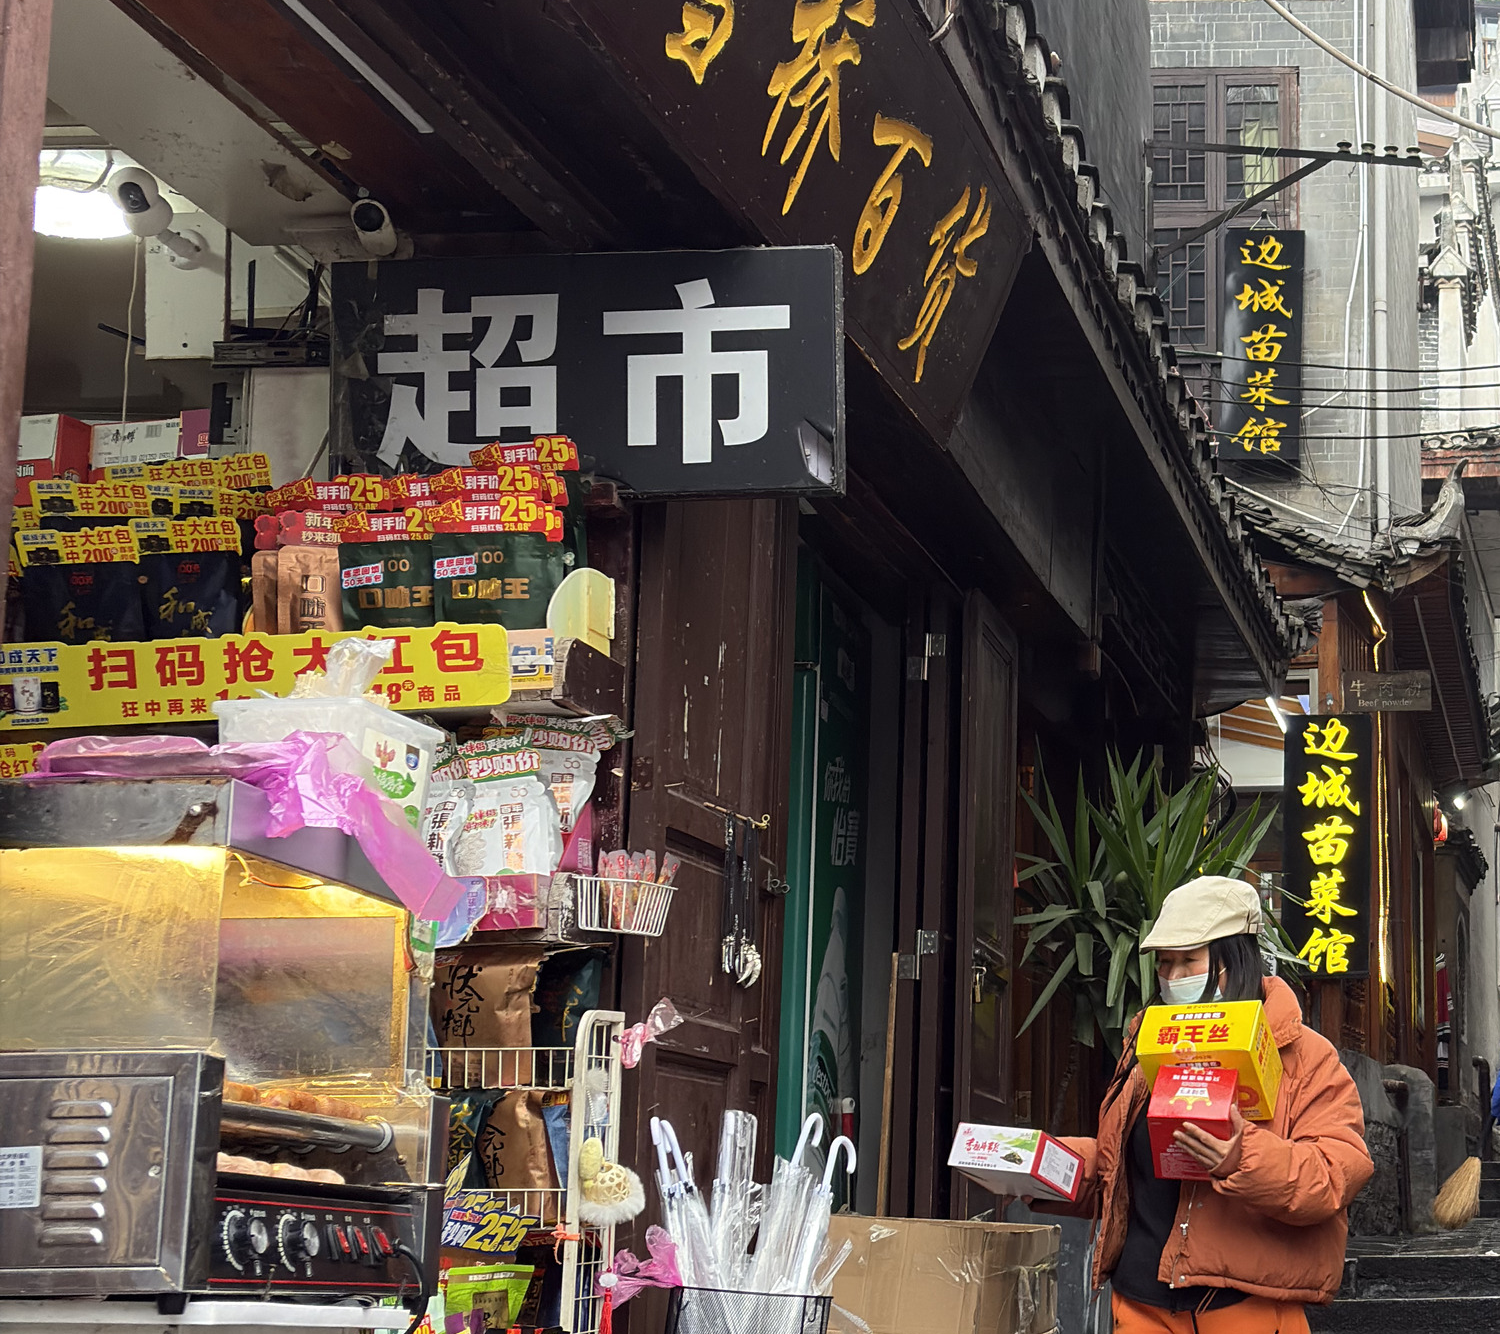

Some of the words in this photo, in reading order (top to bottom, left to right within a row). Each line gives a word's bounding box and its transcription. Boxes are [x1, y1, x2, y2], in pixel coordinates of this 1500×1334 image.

[1231, 235, 1292, 454] 边城苗菜馆
[377, 278, 790, 468] 超市
[316, 485, 349, 500] 到手价
[349, 477, 383, 503] 25
[466, 475, 499, 490] 到手价
[498, 466, 533, 492] 25
[465, 506, 500, 521] 到手价
[500, 496, 537, 522] 25
[371, 517, 406, 531] 到手价
[87, 630, 484, 691] 扫码抢大红包
[1350, 680, 1422, 697] 牛肉粉
[1358, 698, 1378, 707] Beef
[1382, 698, 1413, 708] powder
[468, 750, 541, 779] 秒购价
[1296, 718, 1360, 974] 边城苗菜馆
[1156, 1024, 1230, 1046] 霸王丝
